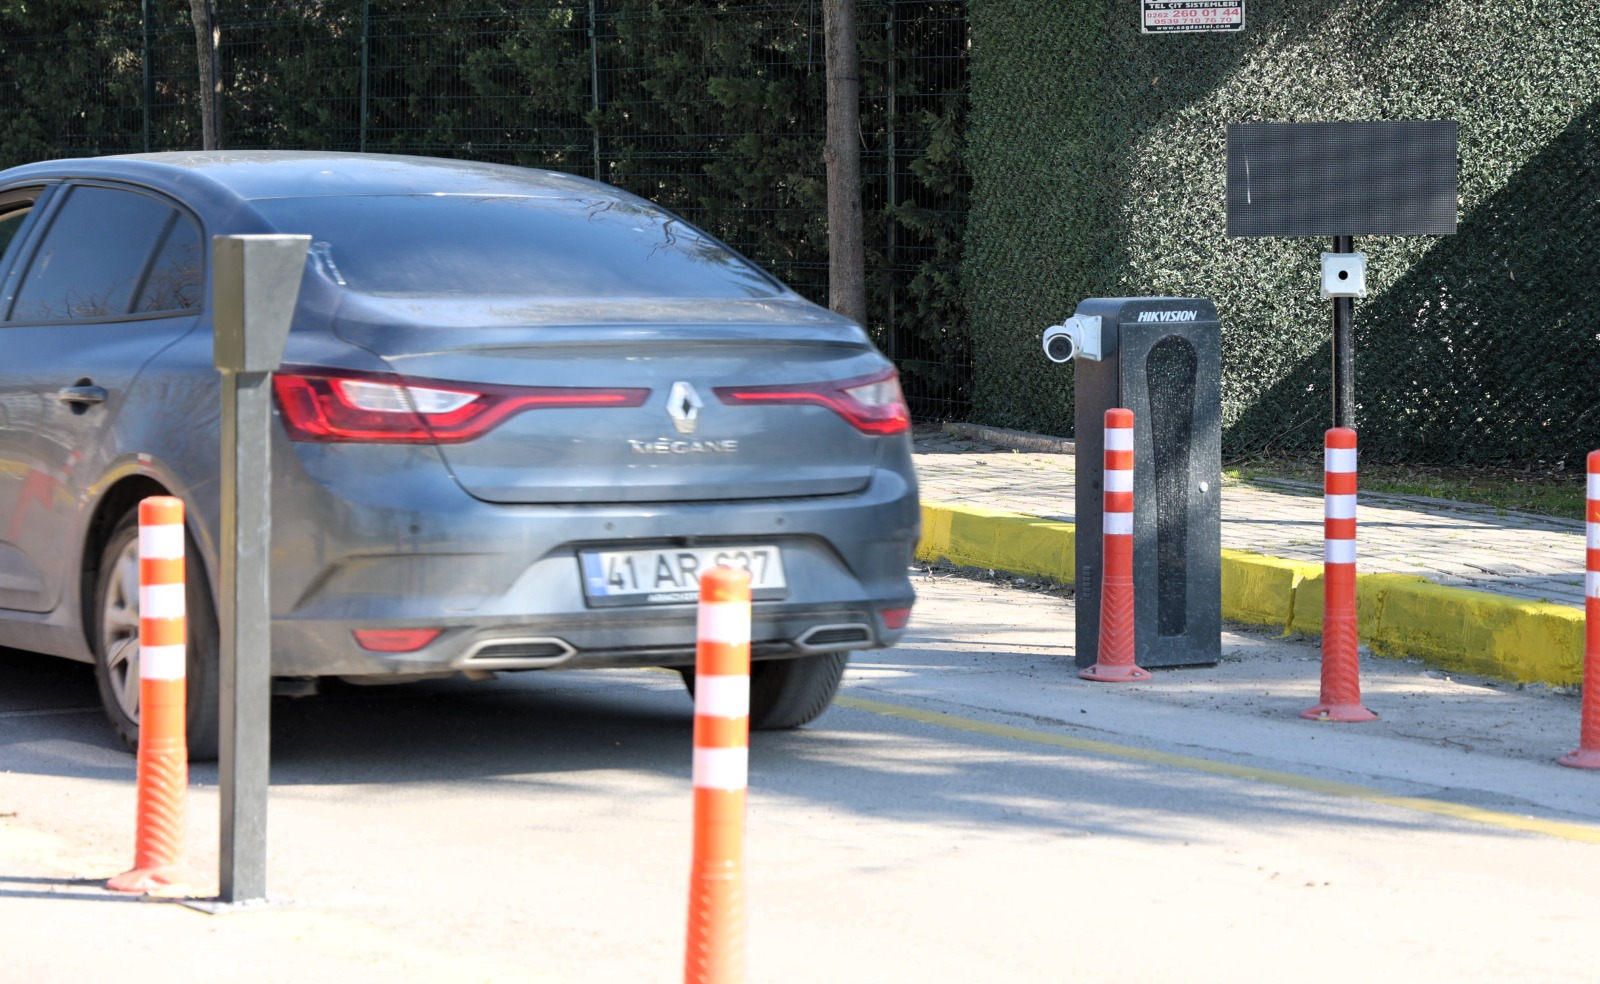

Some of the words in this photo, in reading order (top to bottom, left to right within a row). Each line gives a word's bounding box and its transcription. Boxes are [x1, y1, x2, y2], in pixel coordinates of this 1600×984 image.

[1223, 8, 1239, 16] 44
[1137, 310, 1198, 322] HIKVISION
[608, 556, 640, 590] 41
[654, 552, 700, 589] AR
